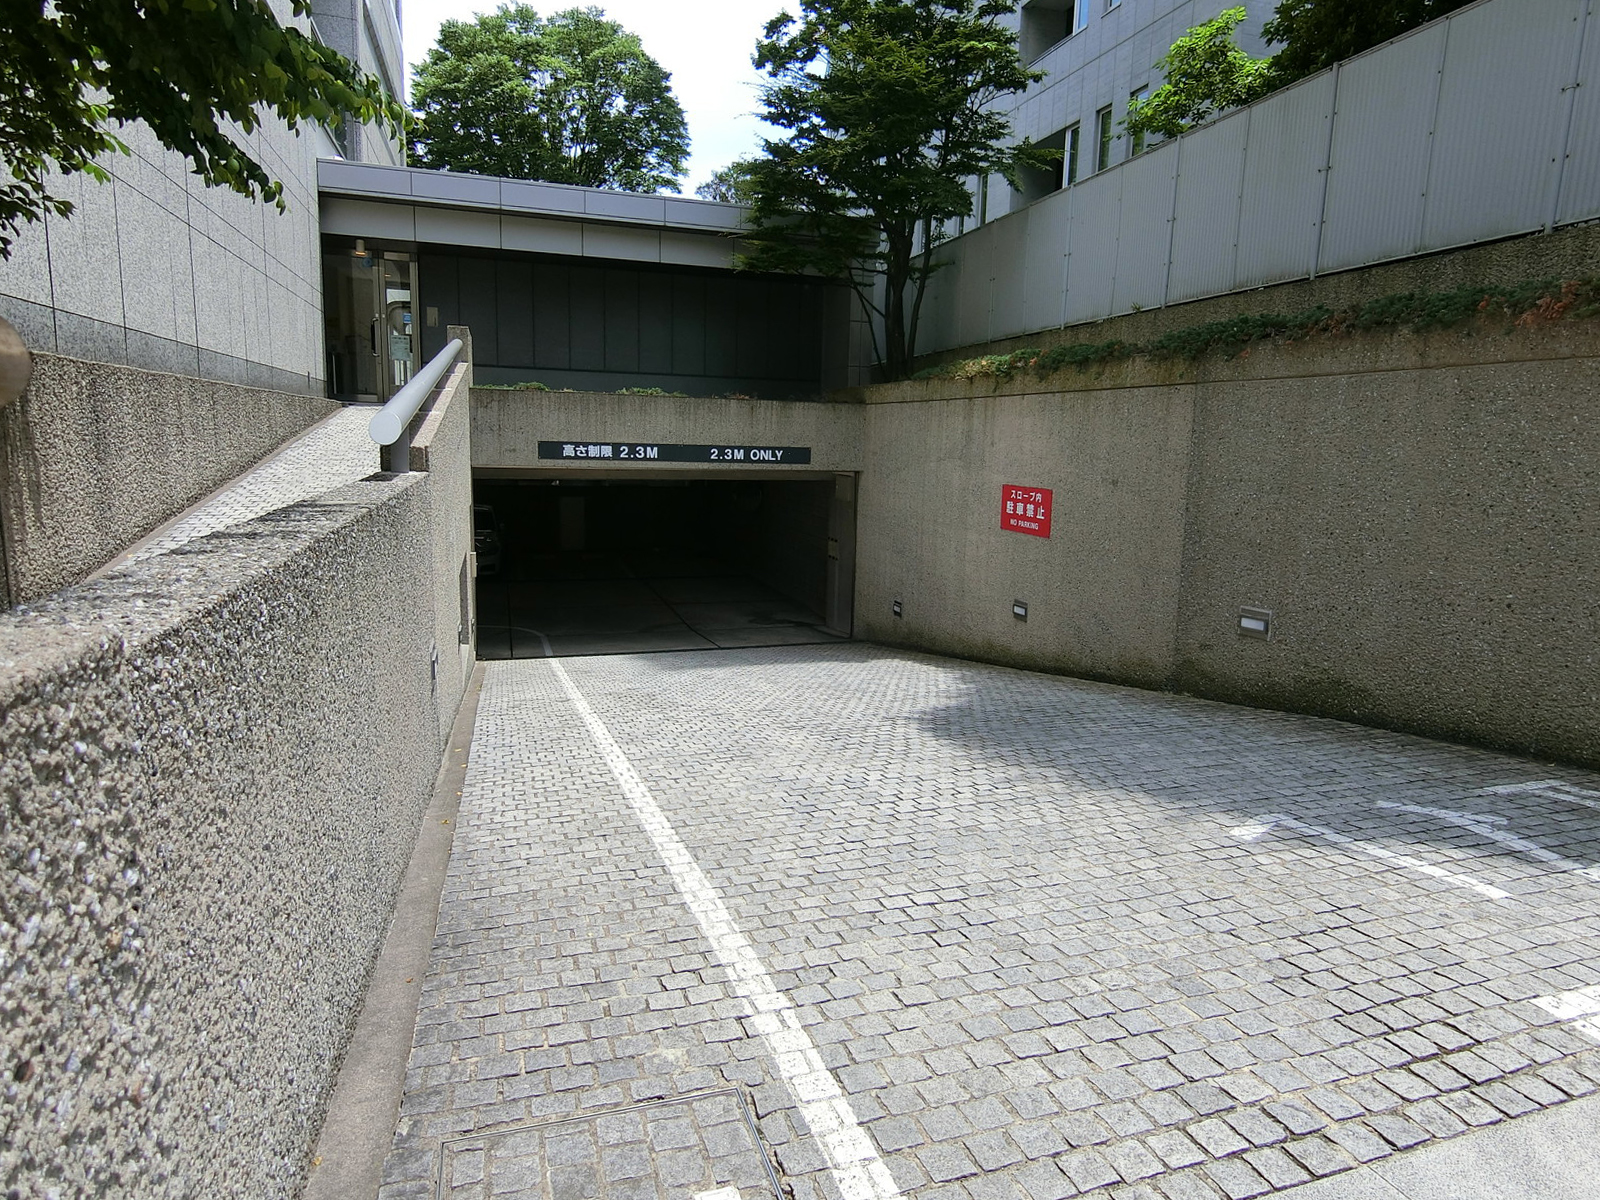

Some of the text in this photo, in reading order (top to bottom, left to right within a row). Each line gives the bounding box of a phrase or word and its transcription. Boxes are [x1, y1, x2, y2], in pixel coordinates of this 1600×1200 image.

[562, 444, 658, 458] 高さ制限 2.3M
[710, 448, 783, 461] 2.3M ONLY
[1010, 490, 1042, 502] スロープ内
[1006, 501, 1045, 519] 駐車禁止
[1018, 520, 1038, 530] PARKING
